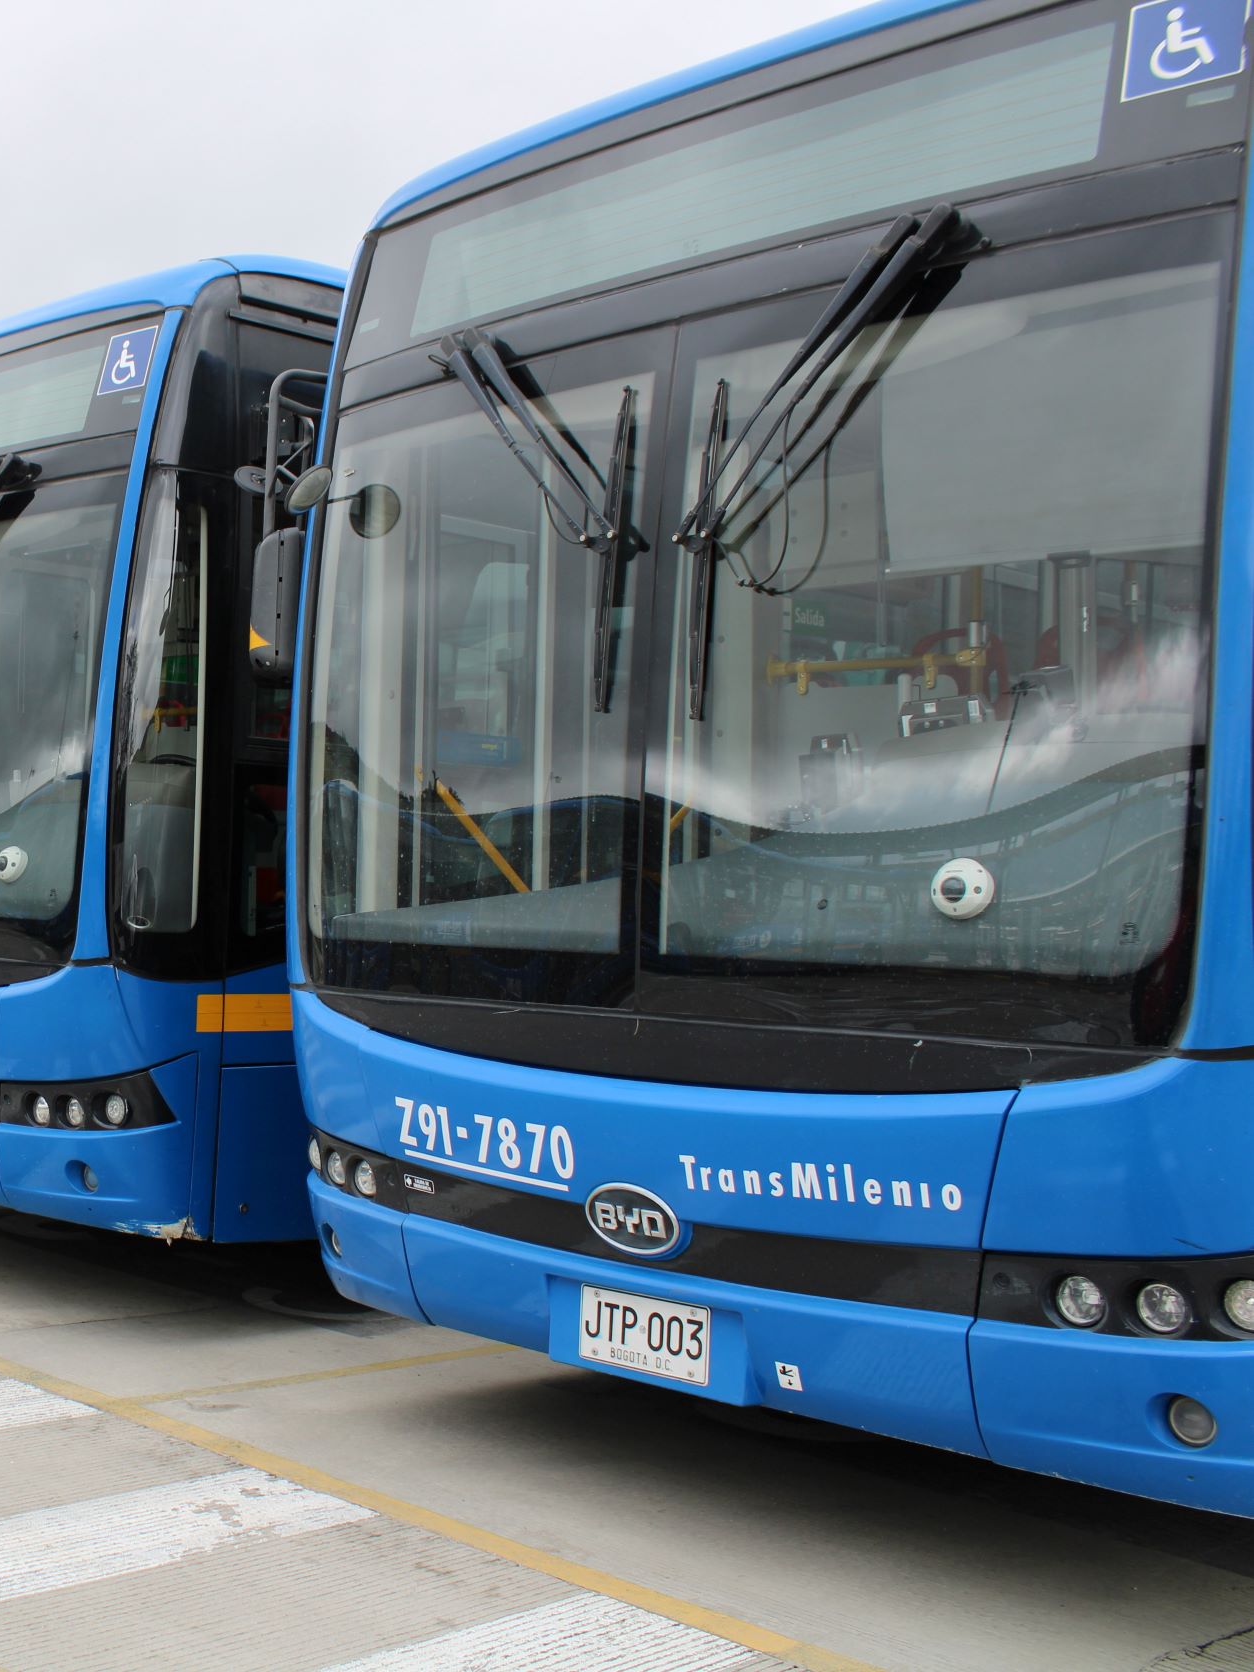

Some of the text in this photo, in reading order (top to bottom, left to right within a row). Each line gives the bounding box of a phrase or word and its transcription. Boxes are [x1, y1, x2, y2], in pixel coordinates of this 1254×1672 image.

[795, 607, 825, 627] Salida
[395, 1096, 575, 1180] Z91-7870
[679, 1155, 963, 1211] TransMilenio
[595, 1202, 667, 1239] BYD
[585, 1301, 703, 1360] JTP 003
[610, 1347, 648, 1366] BOGOTA
